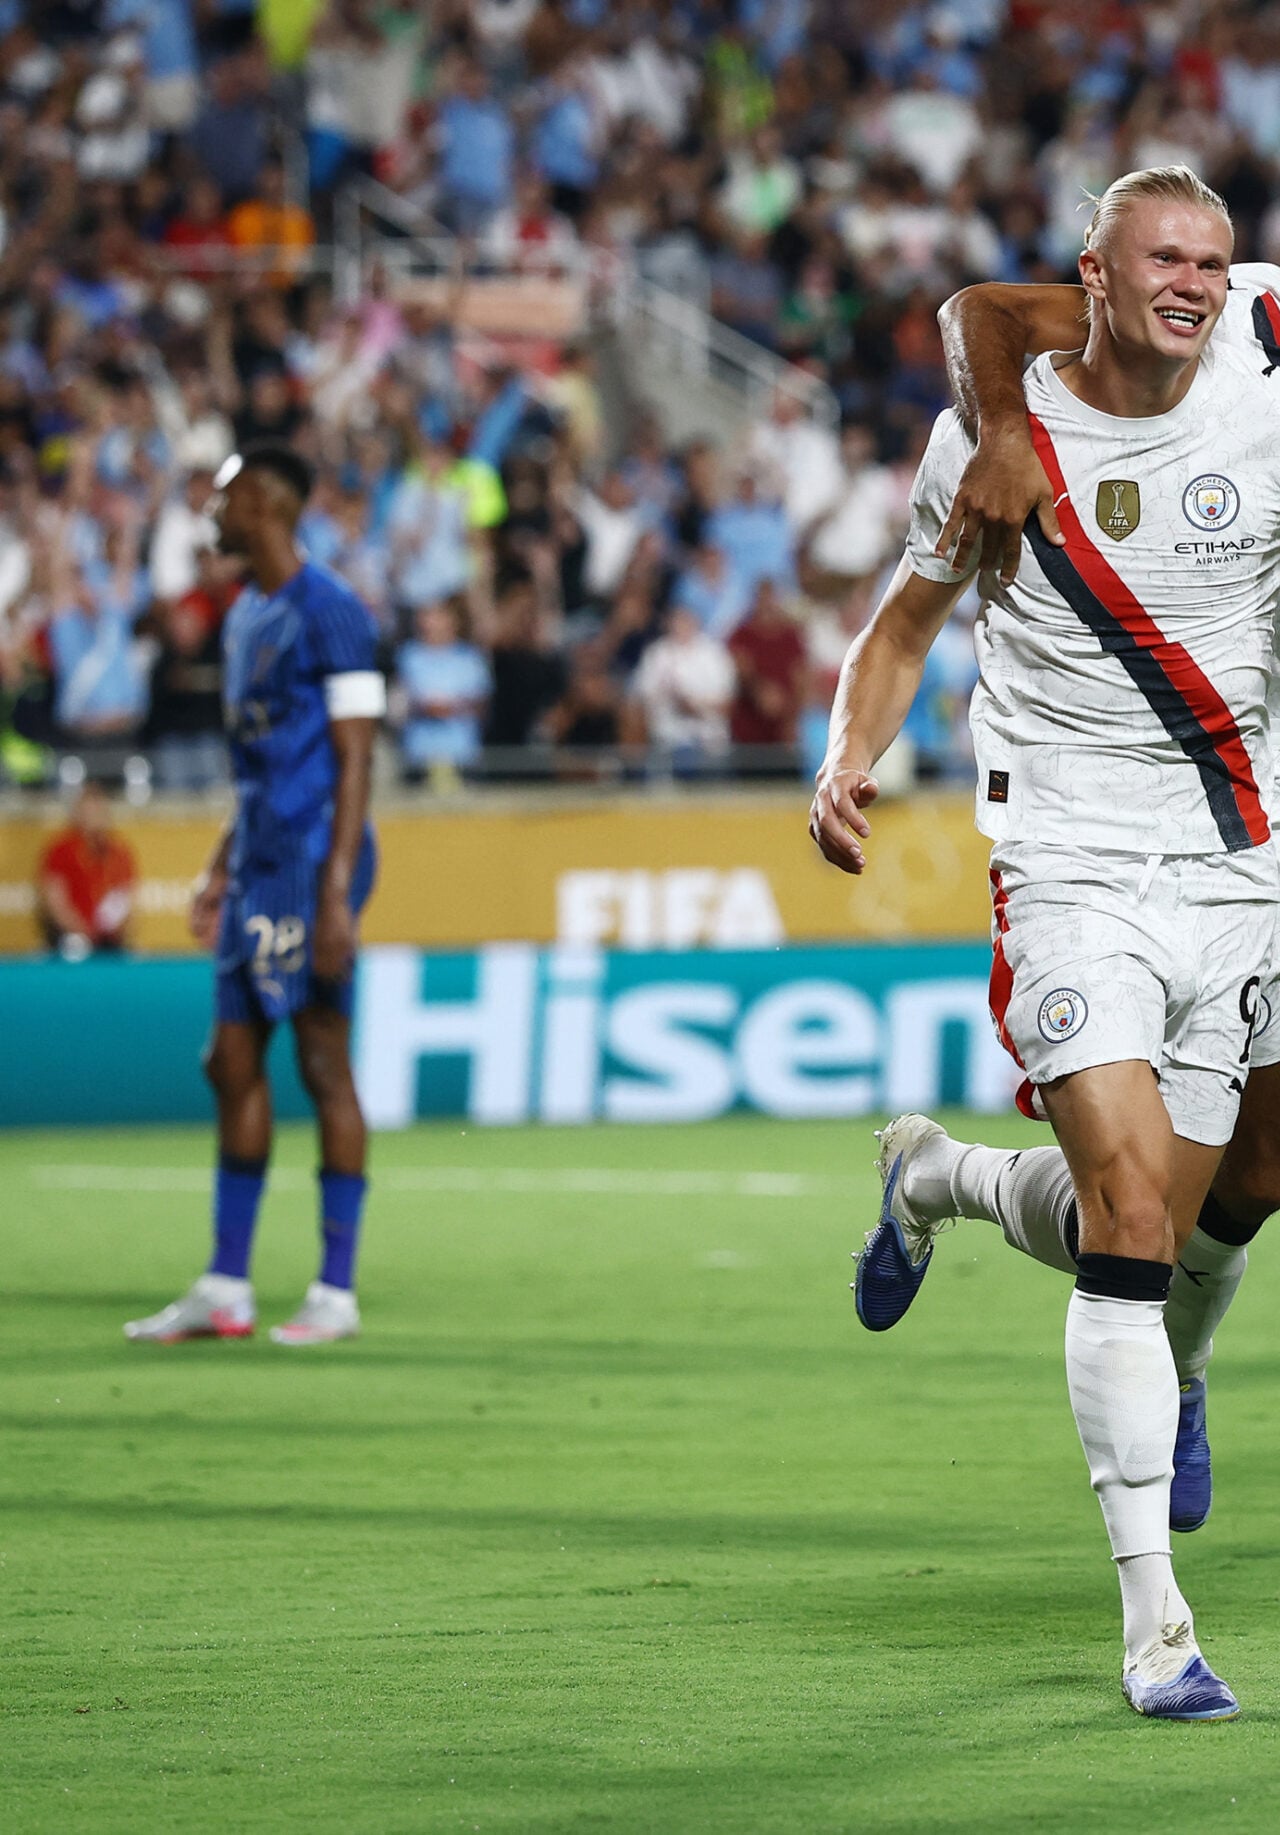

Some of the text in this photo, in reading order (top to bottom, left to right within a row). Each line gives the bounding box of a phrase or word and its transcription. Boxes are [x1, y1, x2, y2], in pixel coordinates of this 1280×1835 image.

[1188, 478, 1233, 497] MANCHESTER
[1108, 518, 1129, 527] FIFA
[1174, 537, 1255, 554] ETIHAD
[1196, 553, 1240, 566] AIRWAYS
[556, 868, 784, 947] FIFA
[1042, 992, 1078, 1020] MANCHESTER
[354, 942, 1020, 1127] Hisen
[1061, 1027, 1075, 1038] CITY
